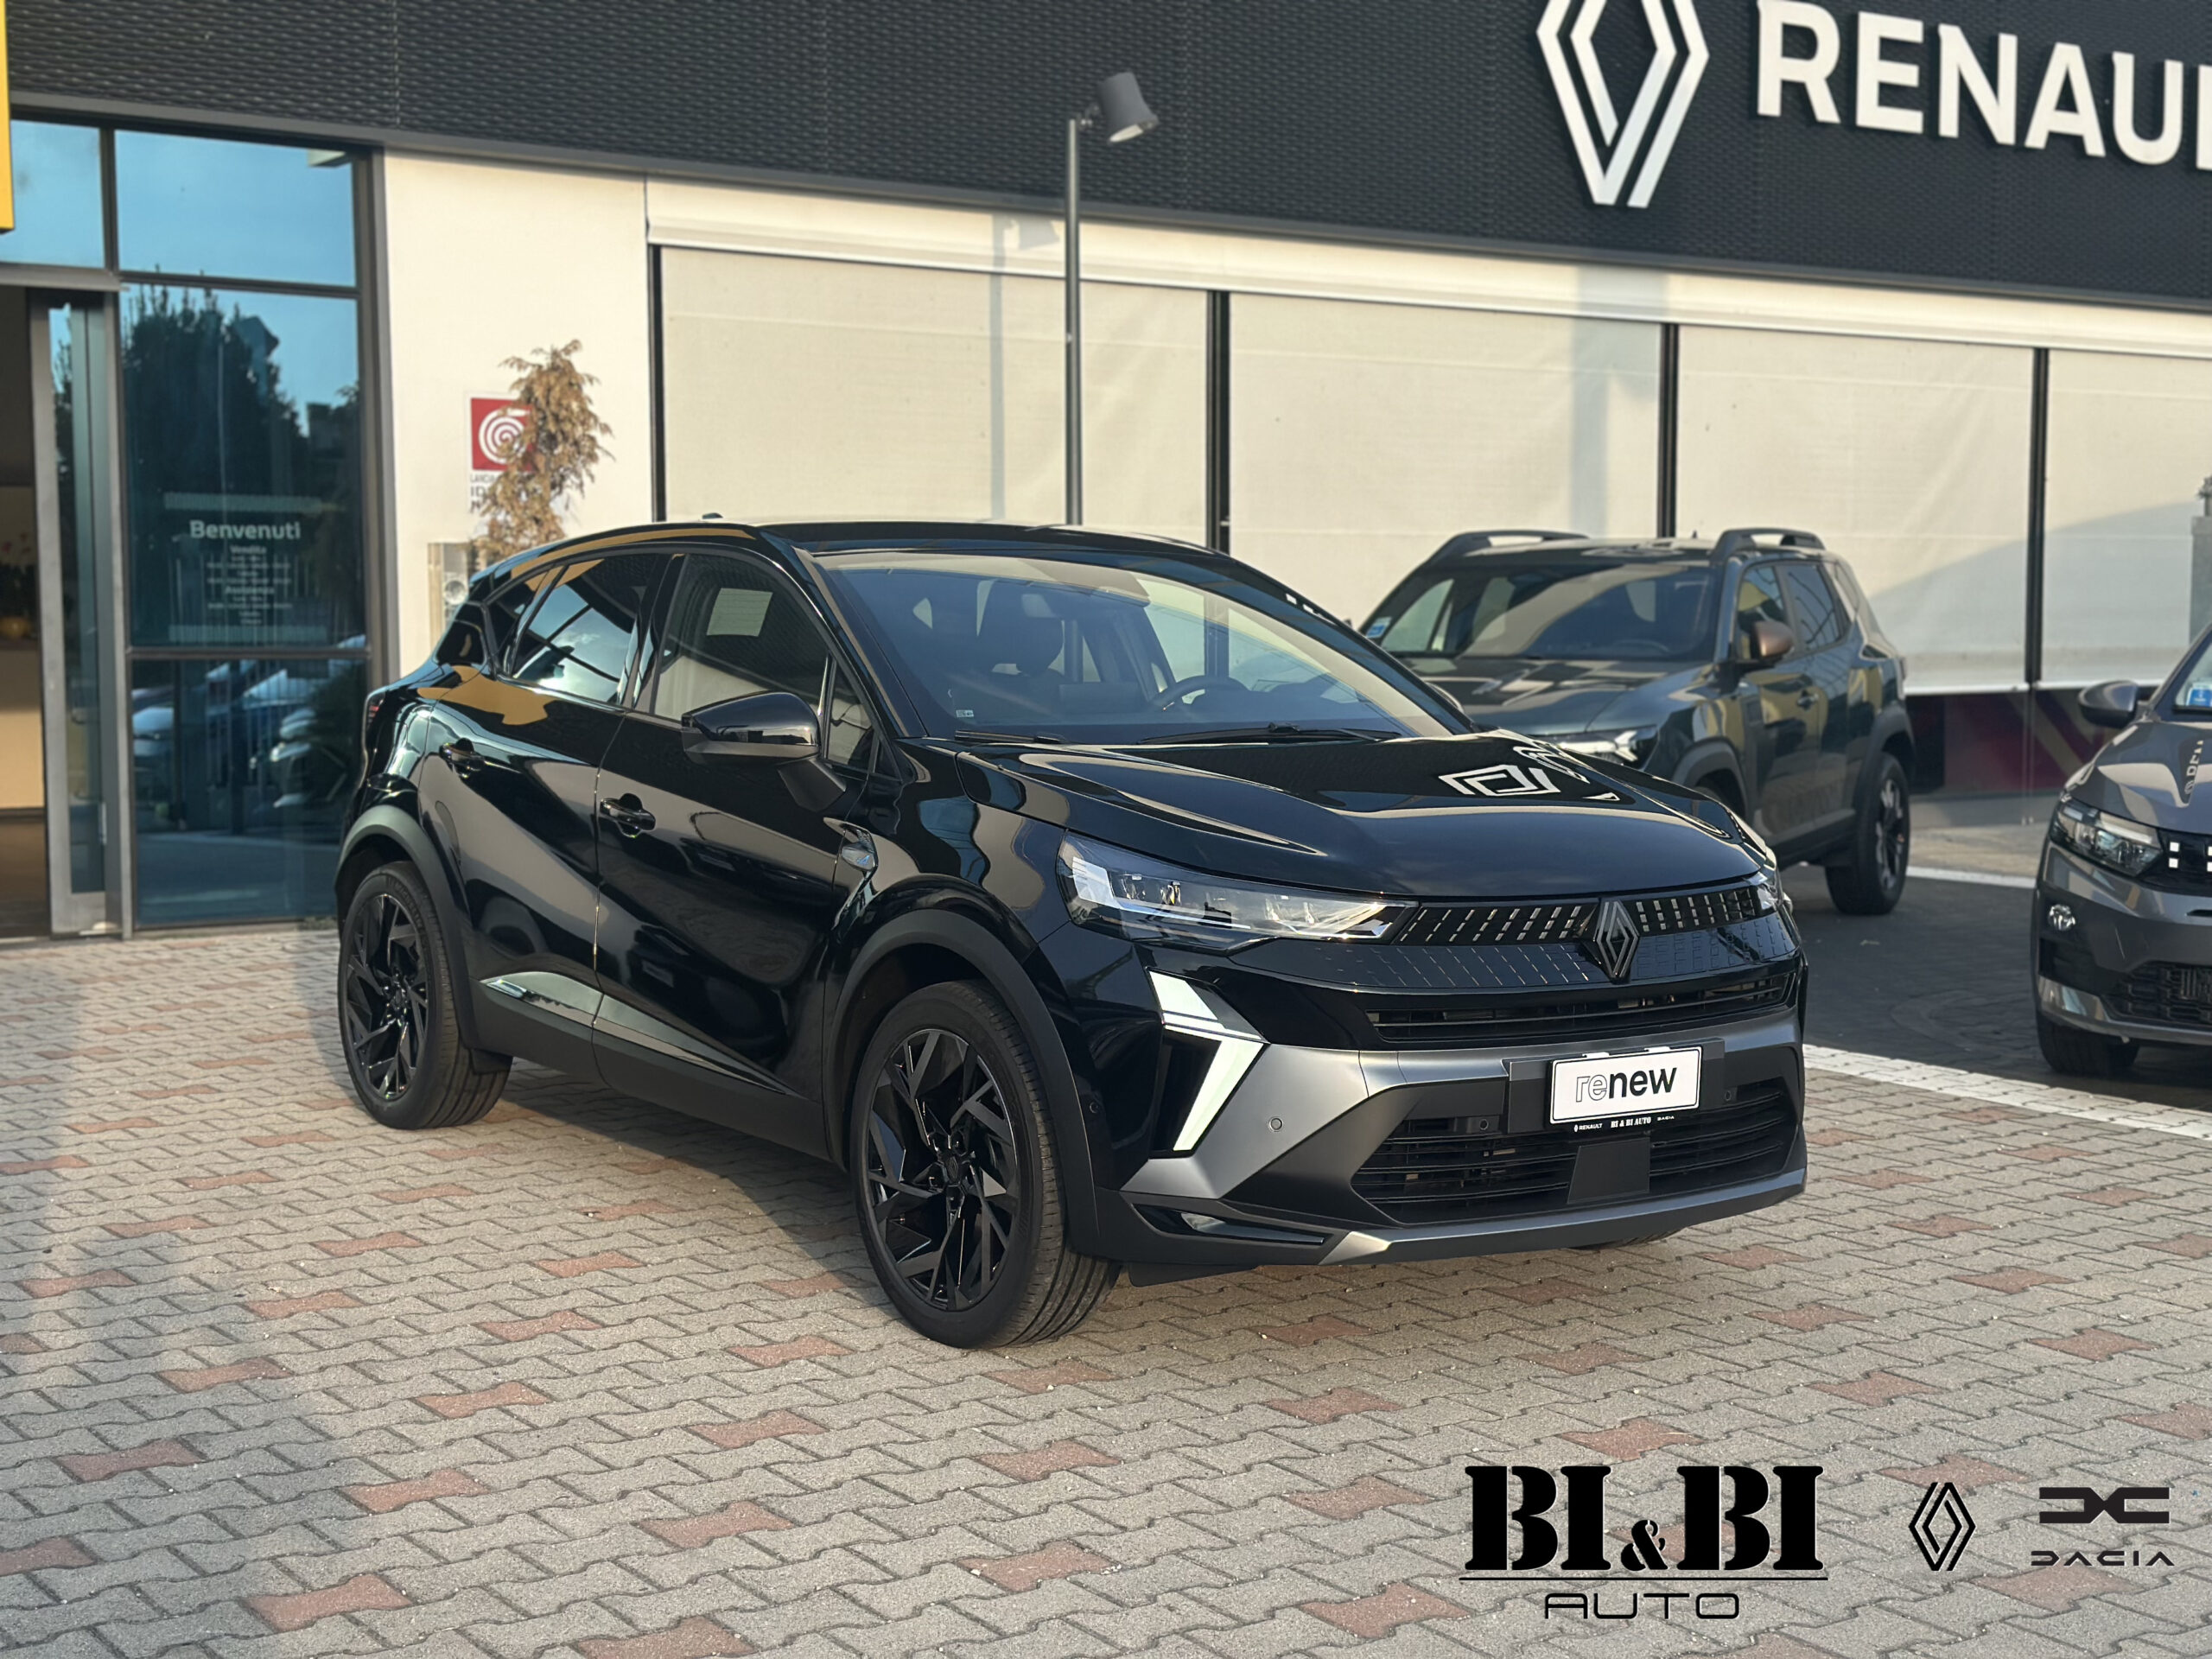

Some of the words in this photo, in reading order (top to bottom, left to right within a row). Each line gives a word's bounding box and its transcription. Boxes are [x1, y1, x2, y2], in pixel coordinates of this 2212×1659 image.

[1757, 0, 2212, 171] RENAU
[189, 519, 302, 539] Benvenuti
[1575, 1067, 1677, 1103] renew
[1634, 1116, 1651, 1126] AUTO
